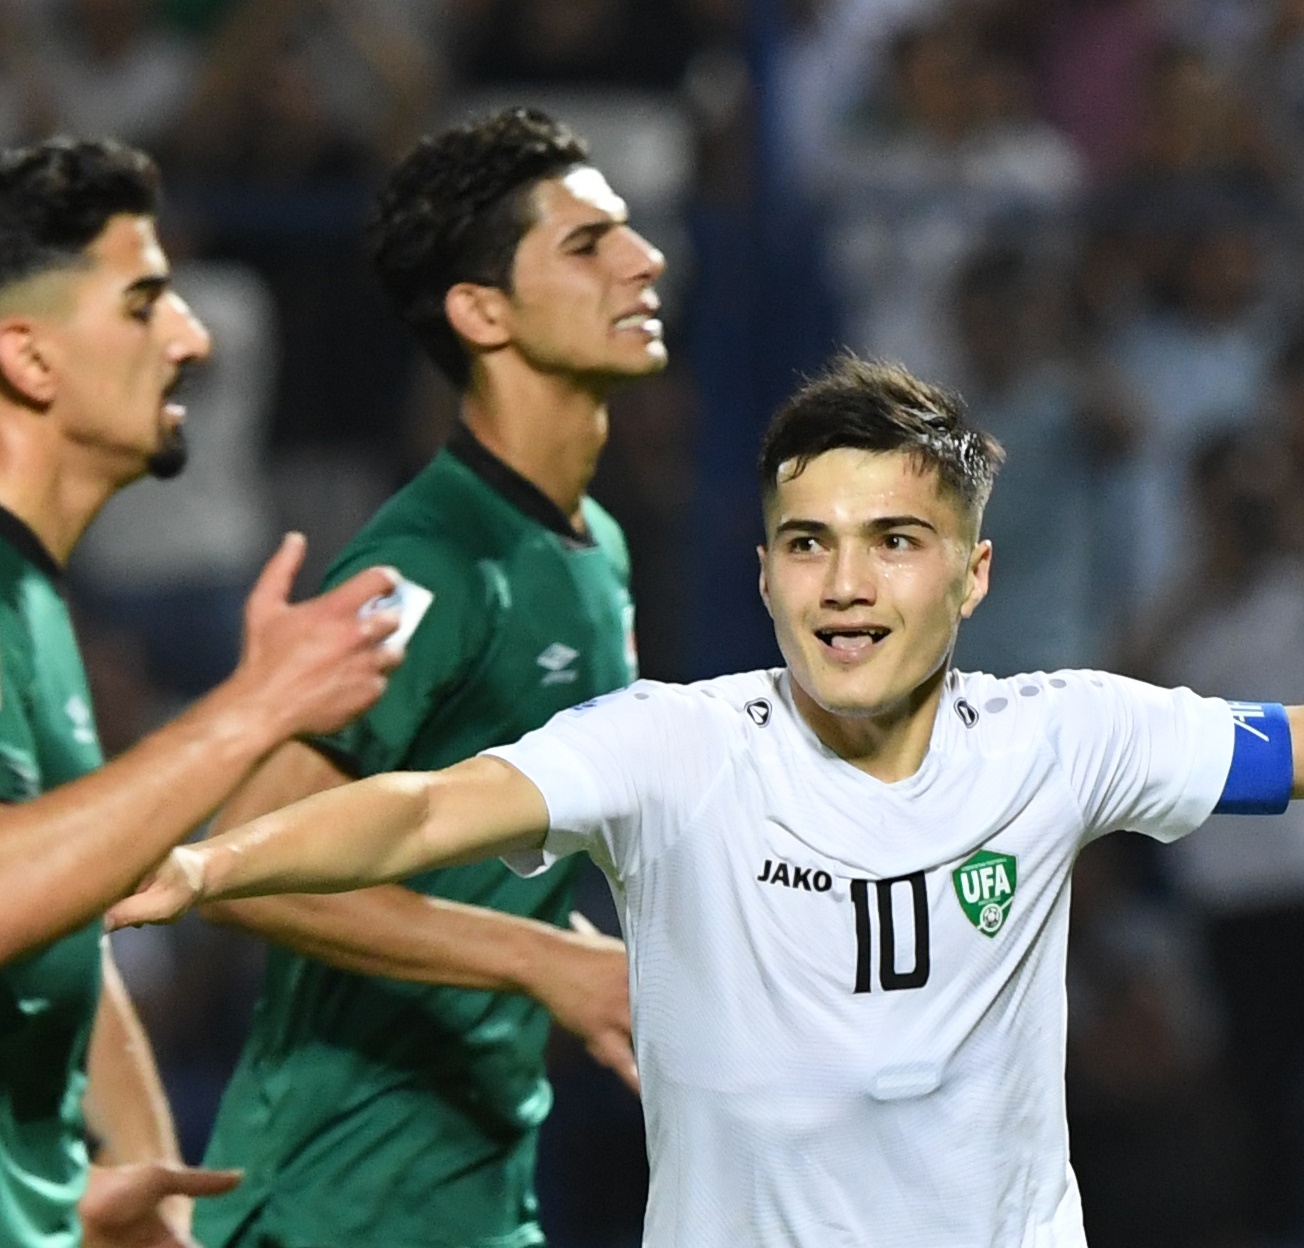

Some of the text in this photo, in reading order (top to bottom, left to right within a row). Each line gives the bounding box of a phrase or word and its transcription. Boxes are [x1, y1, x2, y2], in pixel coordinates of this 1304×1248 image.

[756, 858, 834, 894] JAKO
[960, 863, 1012, 904] UFA
[850, 869, 931, 994] 10
